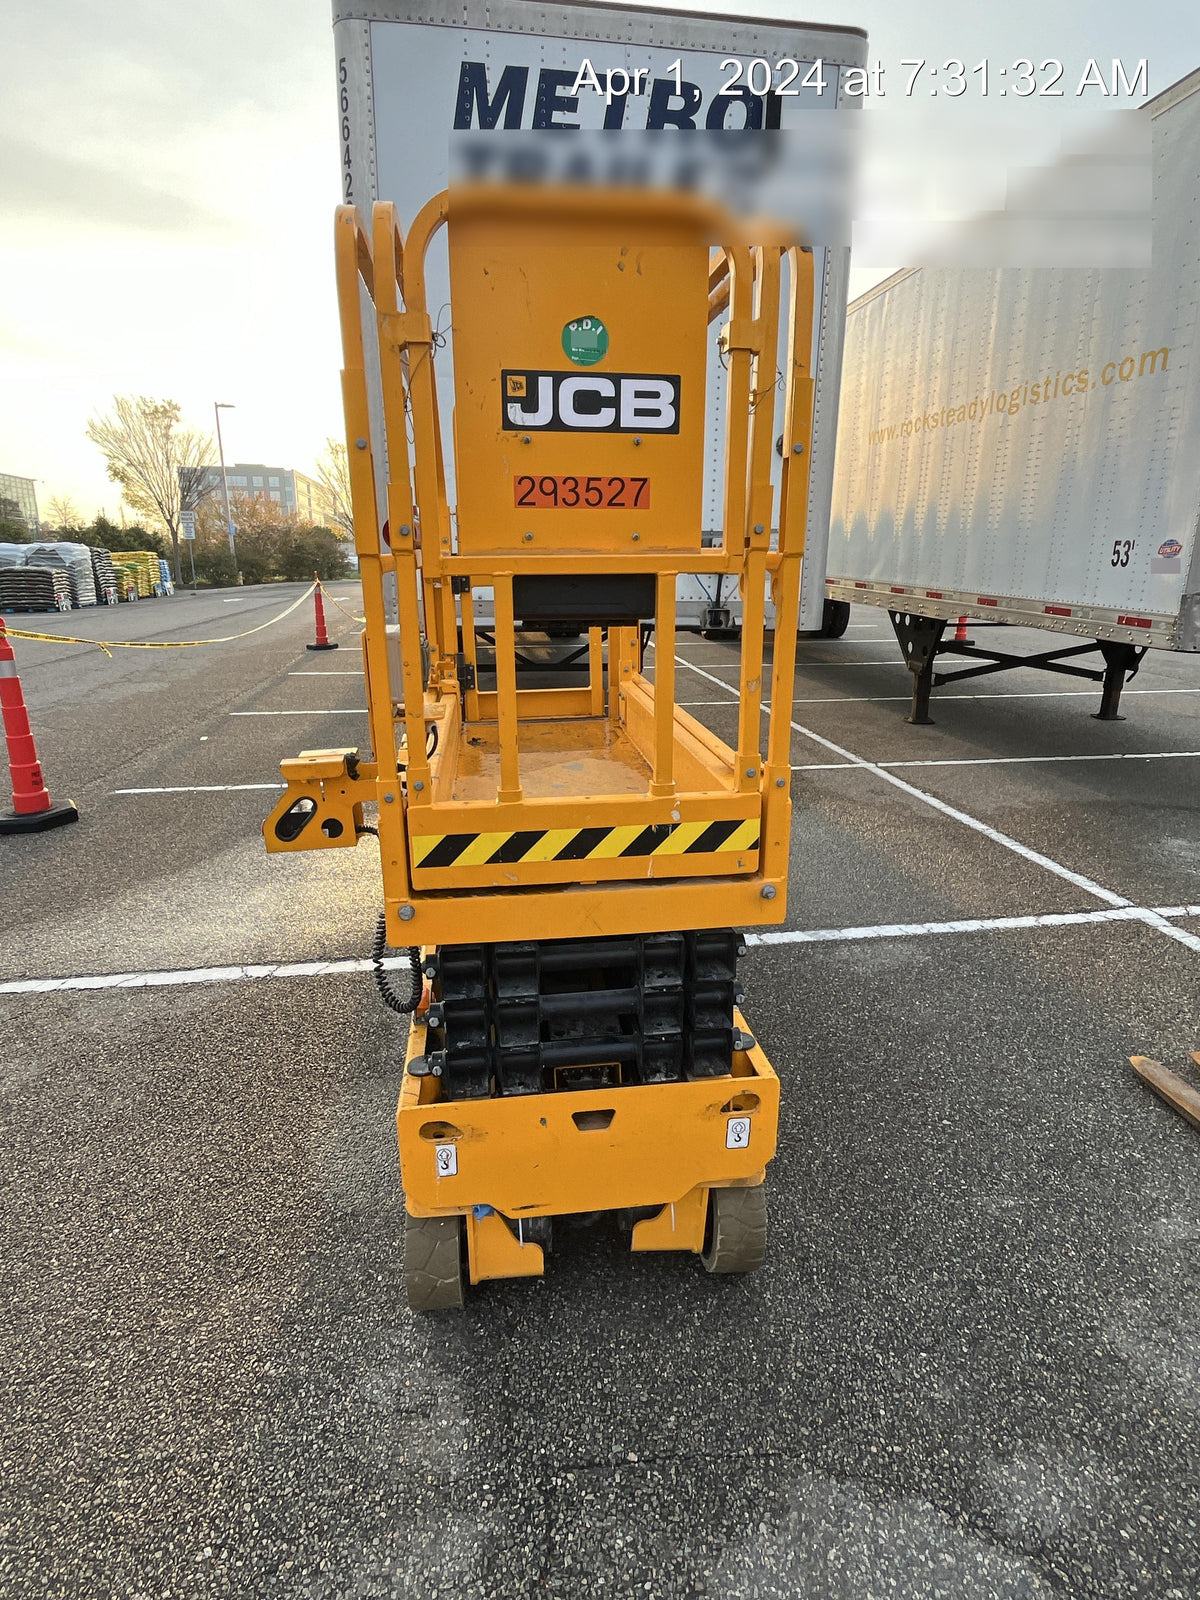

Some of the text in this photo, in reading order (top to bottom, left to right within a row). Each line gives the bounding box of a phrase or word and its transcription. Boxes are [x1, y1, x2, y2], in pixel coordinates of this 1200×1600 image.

[339, 57, 354, 205] 56642
[507, 376, 676, 429] JCB
[867, 346, 1171, 446] www.rocksteadylogistics.com
[516, 475, 648, 507] 293527
[1111, 539, 1136, 568] 53'
[1159, 545, 1181, 555] UTILITY
